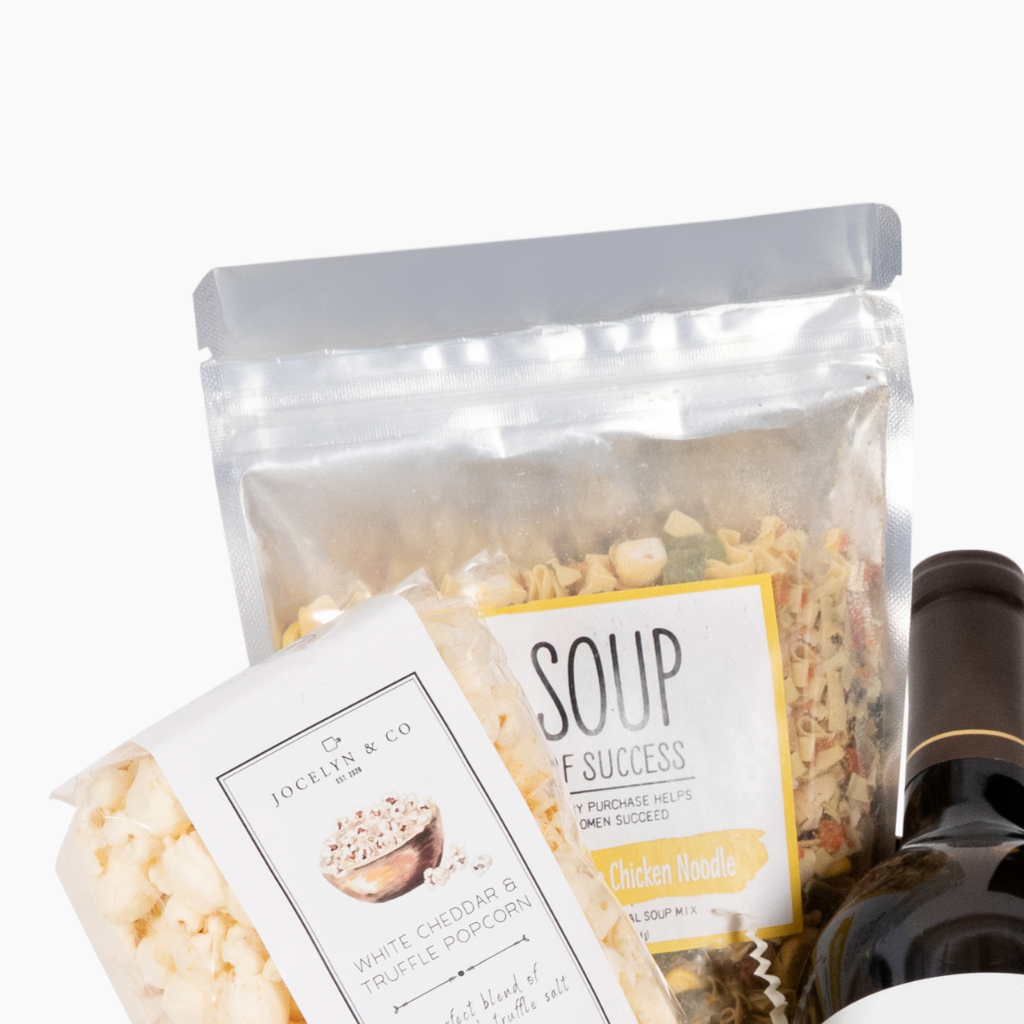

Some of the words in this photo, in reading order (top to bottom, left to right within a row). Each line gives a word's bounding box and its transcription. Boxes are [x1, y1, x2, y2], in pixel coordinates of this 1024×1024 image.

[531, 628, 682, 741] SOUP
[271, 752, 357, 807] JOCELYN
[364, 741, 377, 754] &
[386, 722, 412, 743] CO
[335, 774, 349, 785] EST.
[347, 767, 363, 779] 2020
[559, 754, 574, 783] F
[583, 741, 685, 781] SUCCESS
[580, 817, 611, 829] OMEN
[616, 809, 669, 825] SUCCEED
[588, 795, 649, 812] PURCHASE
[654, 790, 692, 803] HELPS
[610, 856, 672, 890] Chicken
[677, 847, 736, 883] Noodle
[353, 935, 412, 973] WHITE
[417, 889, 499, 941] CHEDDAR
[502, 877, 518, 892] &
[644, 908, 672, 921] SOUP
[675, 906, 697, 916] MIX
[361, 946, 440, 995] TRUFFLE
[444, 894, 533, 951] POPCORN
[483, 979, 522, 1009] blend
[527, 964, 541, 985] of
[544, 977, 570, 1004] salt
